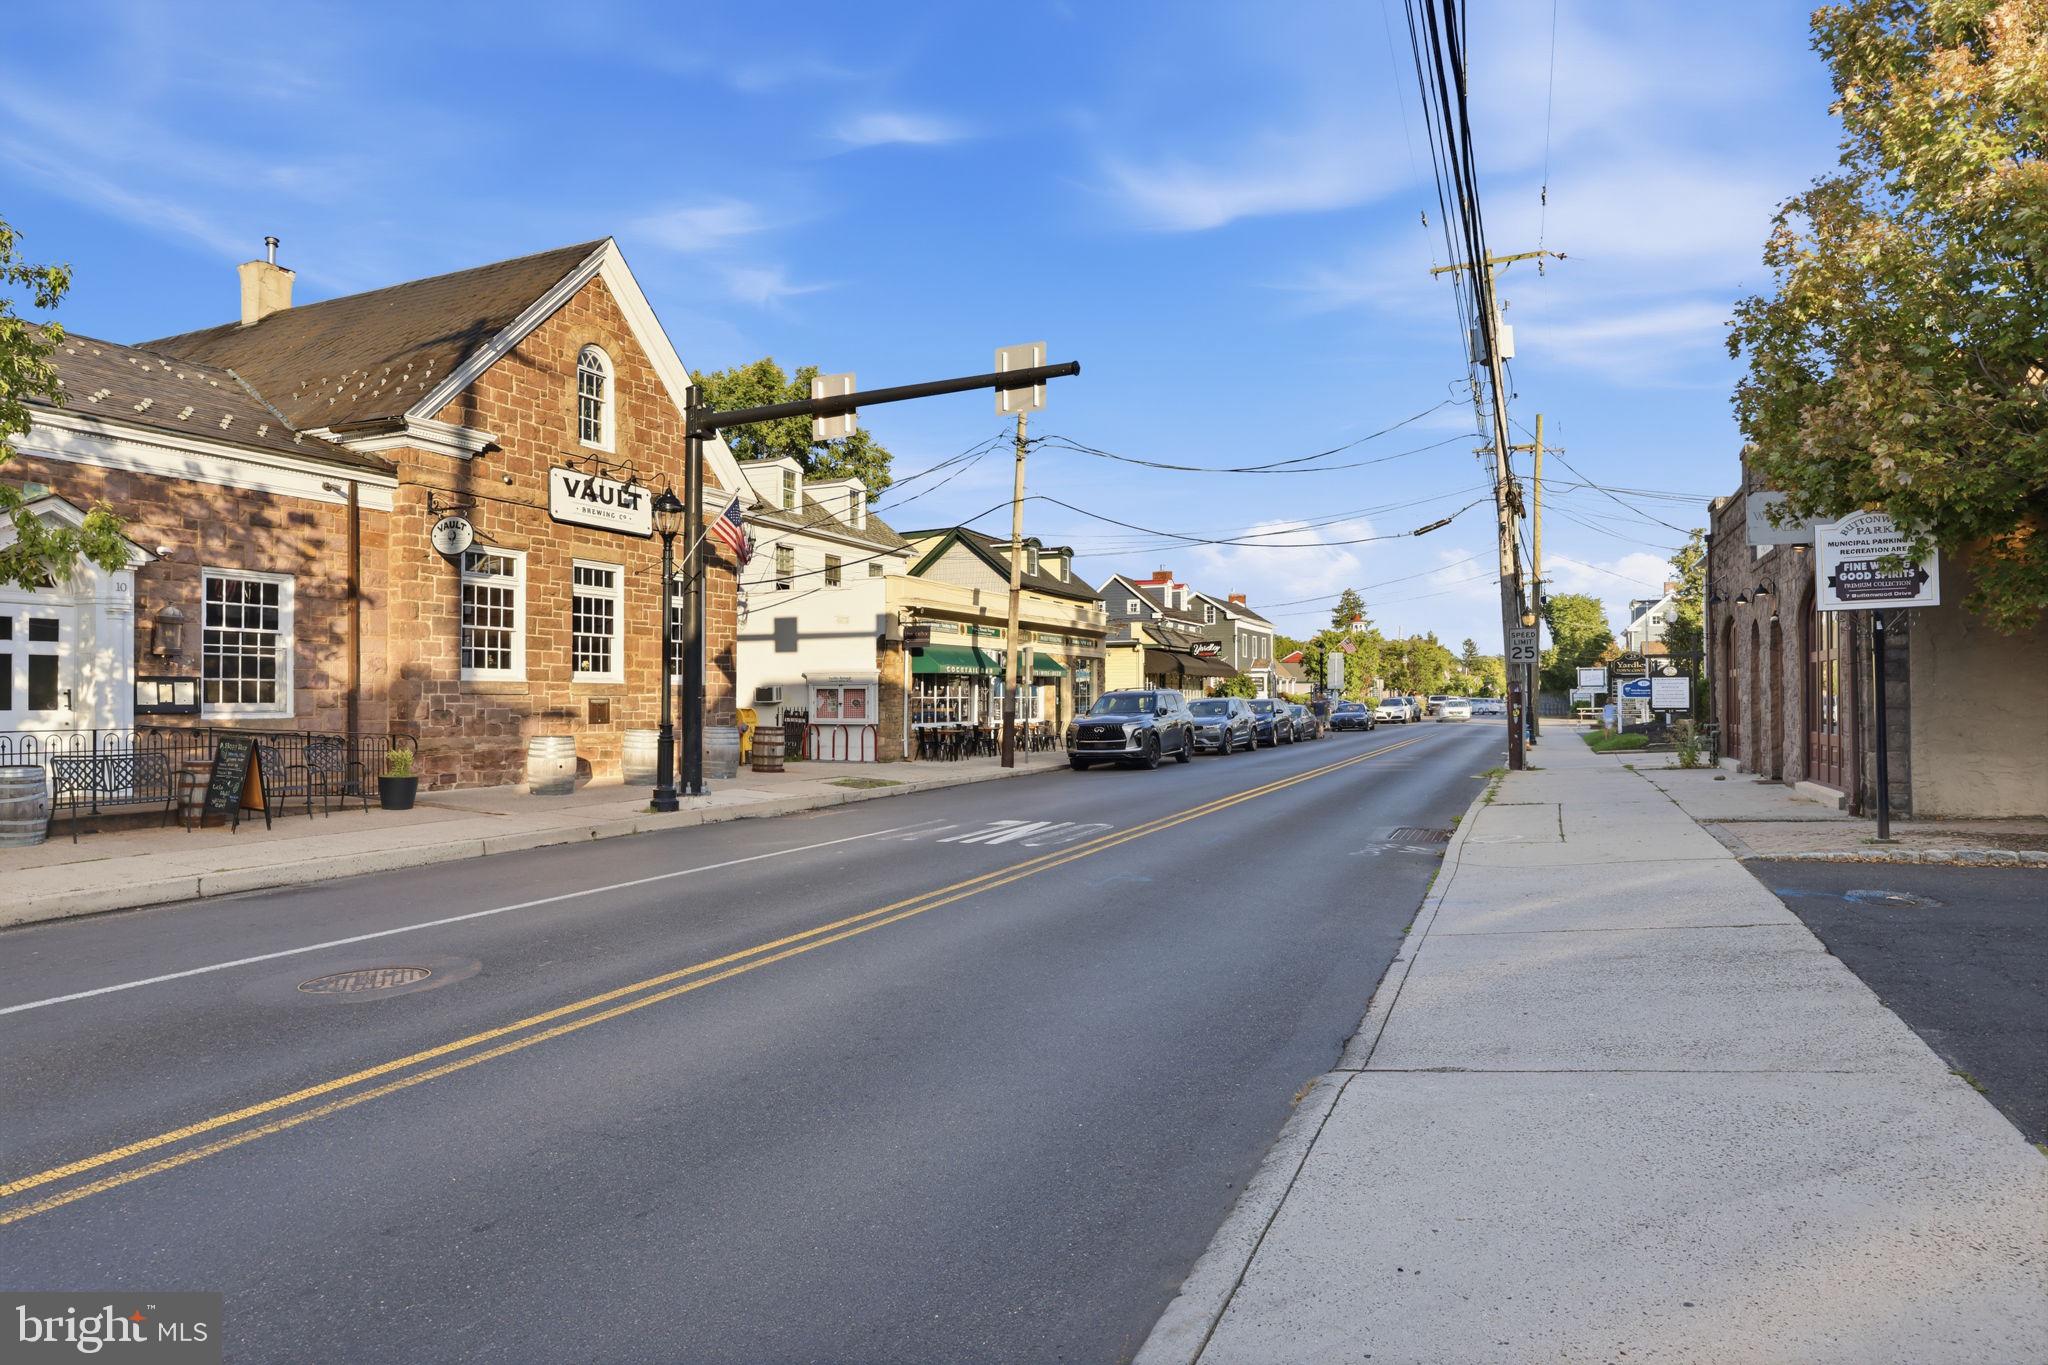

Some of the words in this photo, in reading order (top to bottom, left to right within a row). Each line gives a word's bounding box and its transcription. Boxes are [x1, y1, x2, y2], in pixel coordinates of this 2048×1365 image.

[563, 477, 642, 510] VAULT
[581, 506, 616, 519] BREWING
[437, 521, 467, 532] VAULT
[1857, 526, 1893, 535] PARK
[1840, 547, 1889, 555] RECREATION
[1844, 562, 1867, 571] FINE
[1840, 571, 1872, 581] GOOD
[1874, 568, 1915, 580] SPIRITS
[115, 582, 127, 593] 10
[1873, 580, 1912, 588] COLLECTION
[1512, 646, 1535, 659] 25
[946, 665, 979, 674] COCKTAIL
